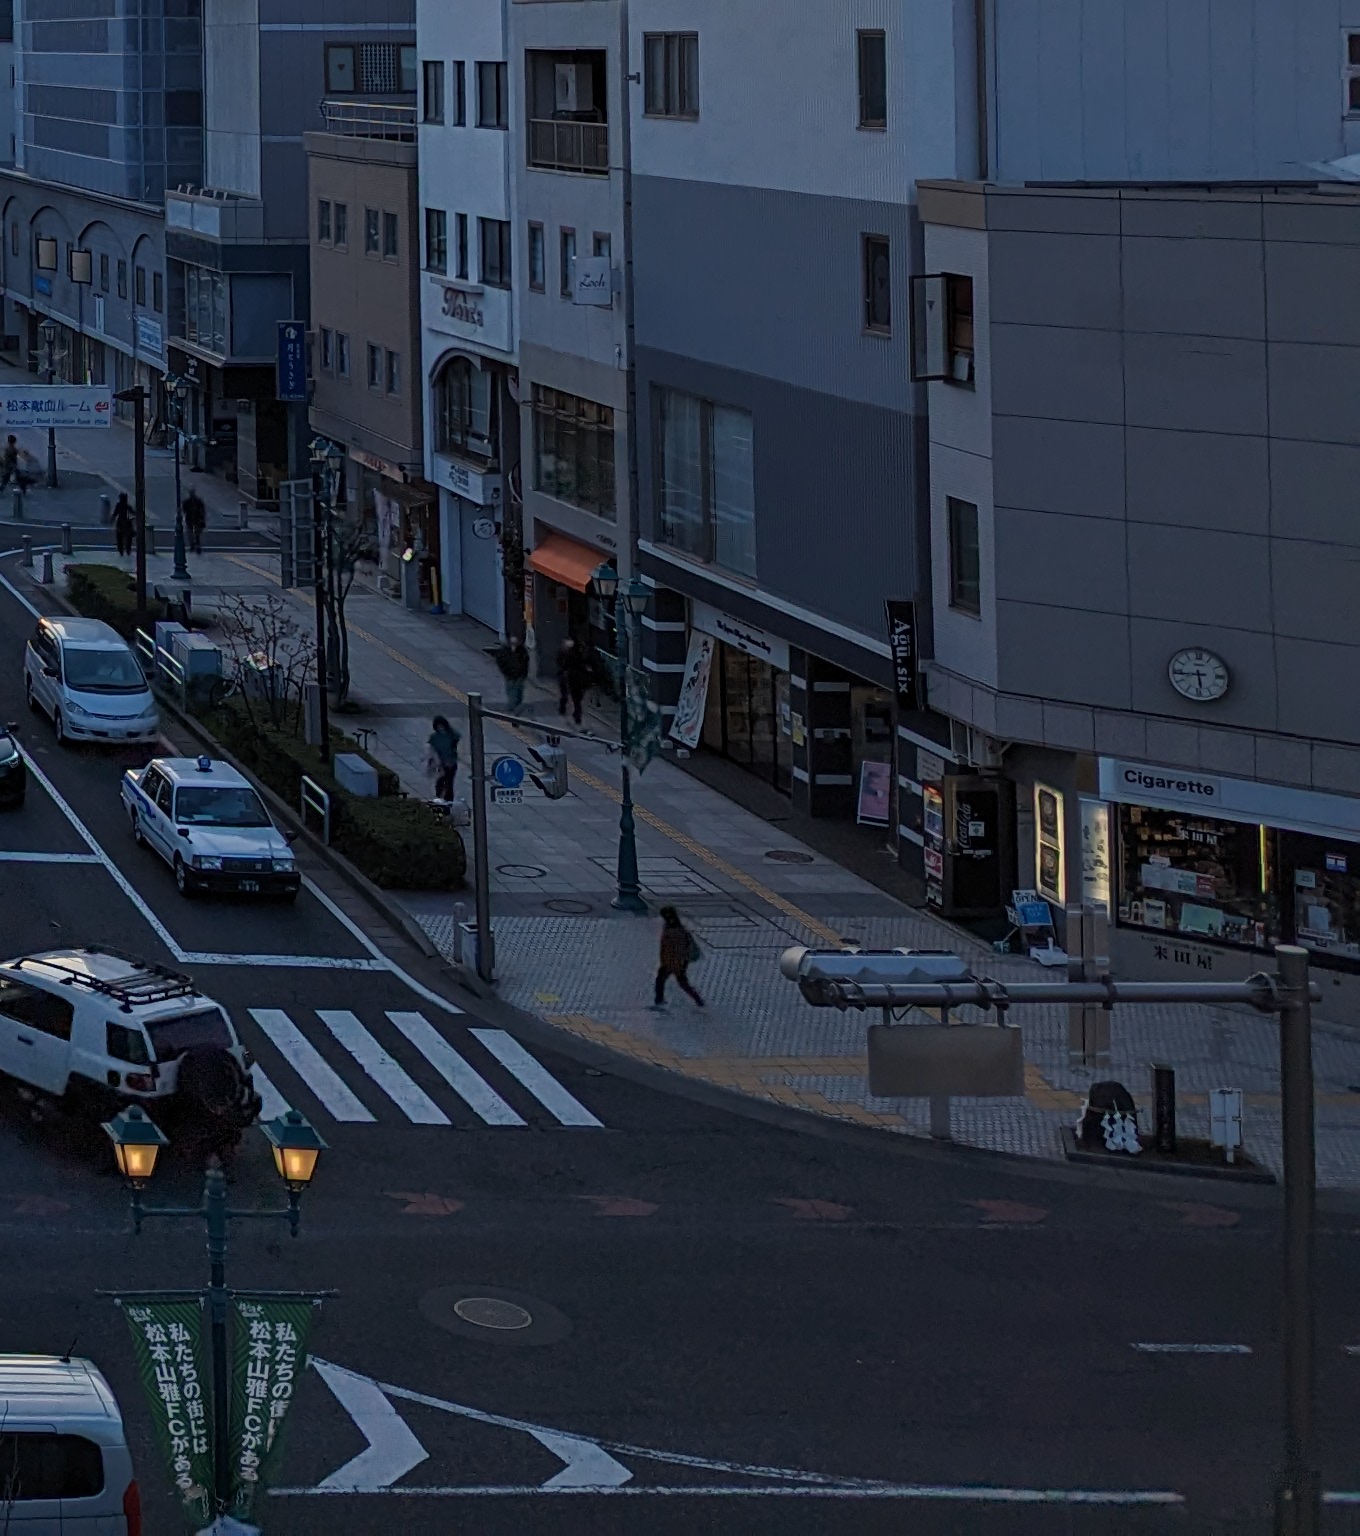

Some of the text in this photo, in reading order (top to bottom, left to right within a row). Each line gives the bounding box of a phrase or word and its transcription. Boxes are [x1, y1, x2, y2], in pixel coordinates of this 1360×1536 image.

[1123, 769, 1216, 796] Cigarette
[143, 1322, 193, 1489] 松本山雅FCがある
[168, 1322, 209, 1455] 私たちの街には
[239, 1319, 273, 1483] 松本山雅FCがある
